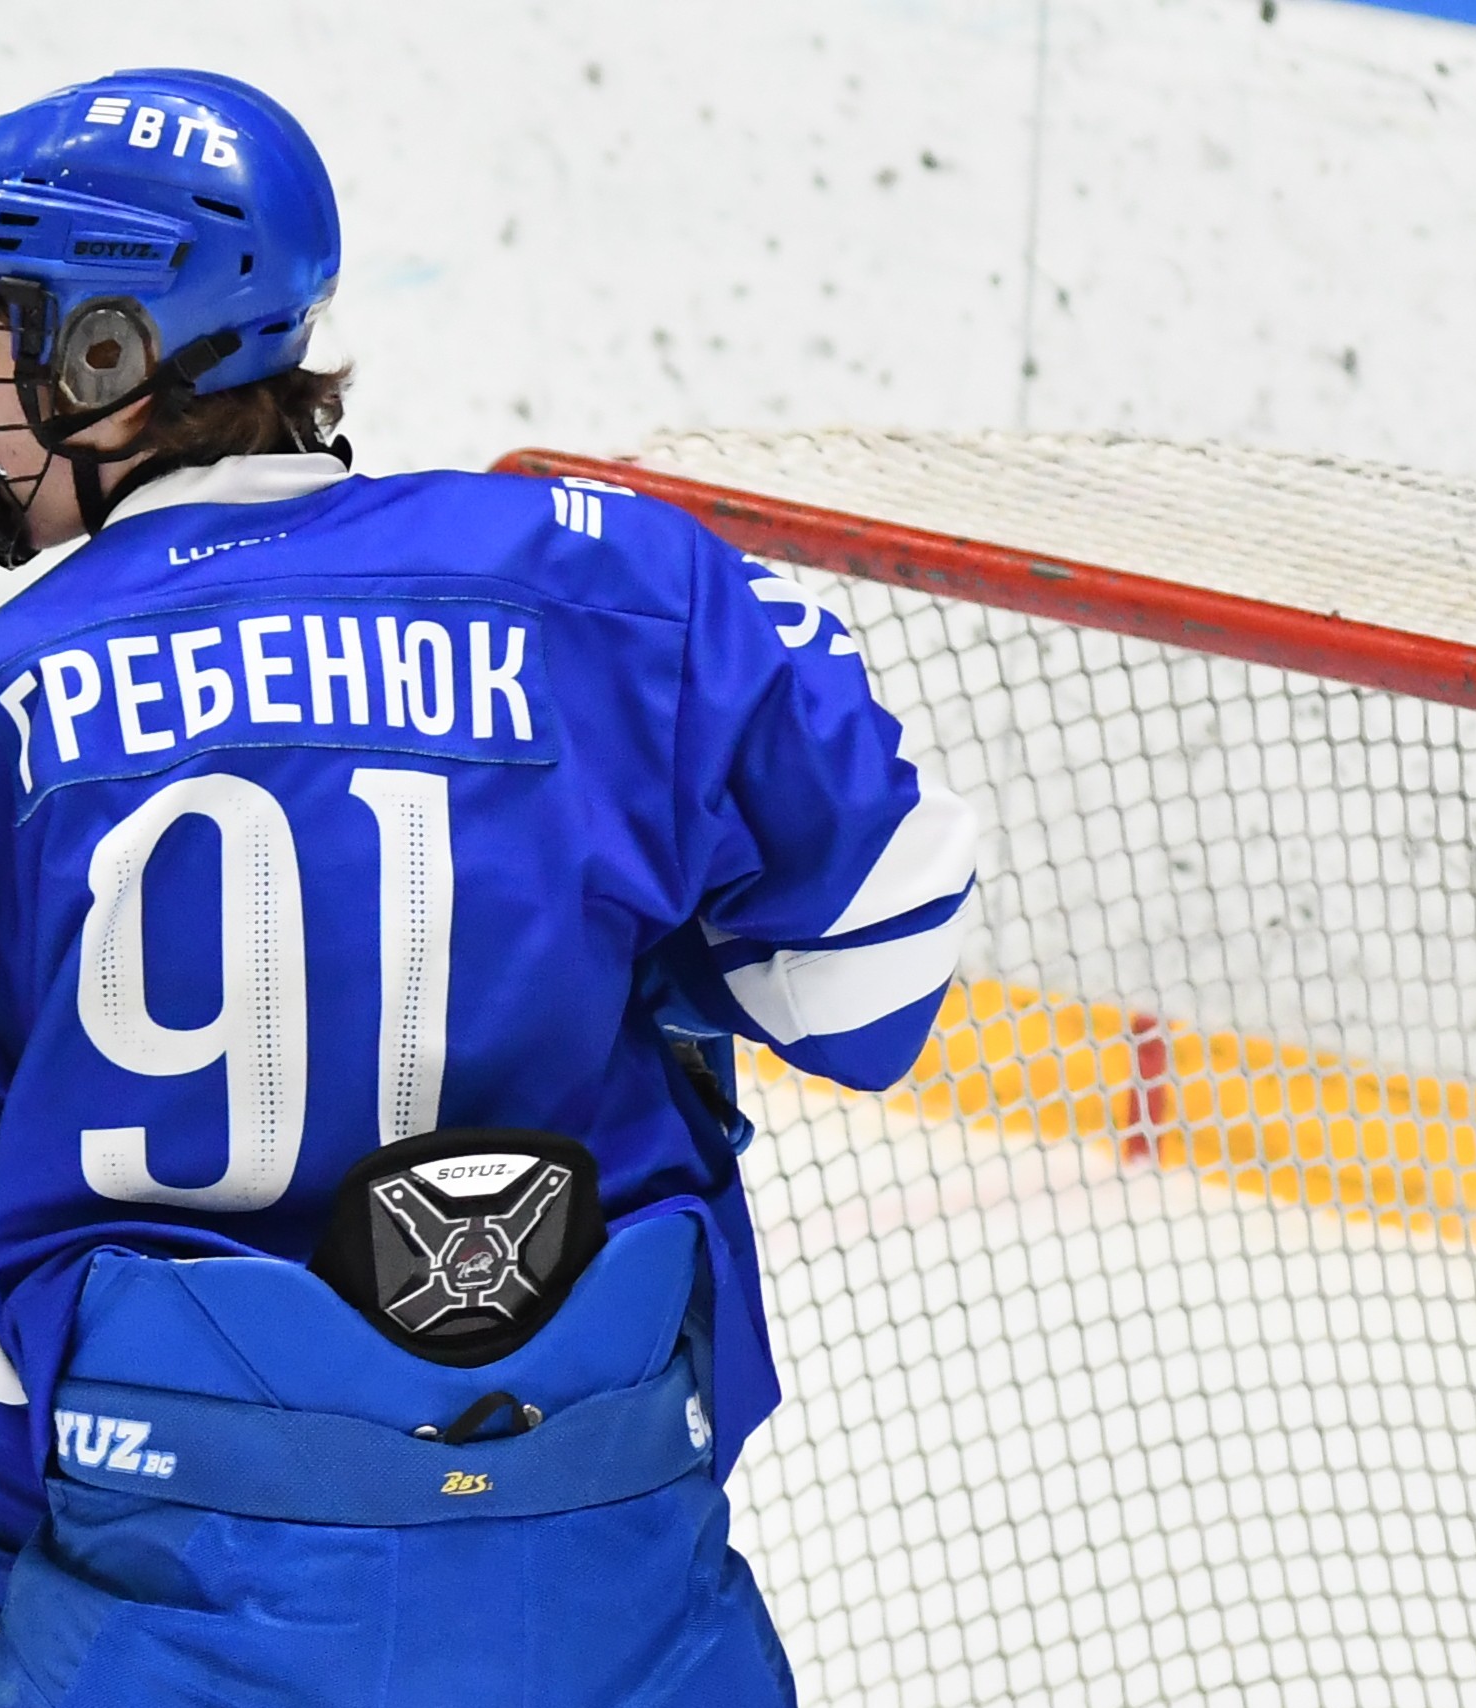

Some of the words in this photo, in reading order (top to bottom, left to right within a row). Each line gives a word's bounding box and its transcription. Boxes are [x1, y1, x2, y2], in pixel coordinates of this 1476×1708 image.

[128, 106, 238, 168] ВТБ
[77, 766, 454, 1213] 91
[436, 1163, 507, 1180] SOYUZ
